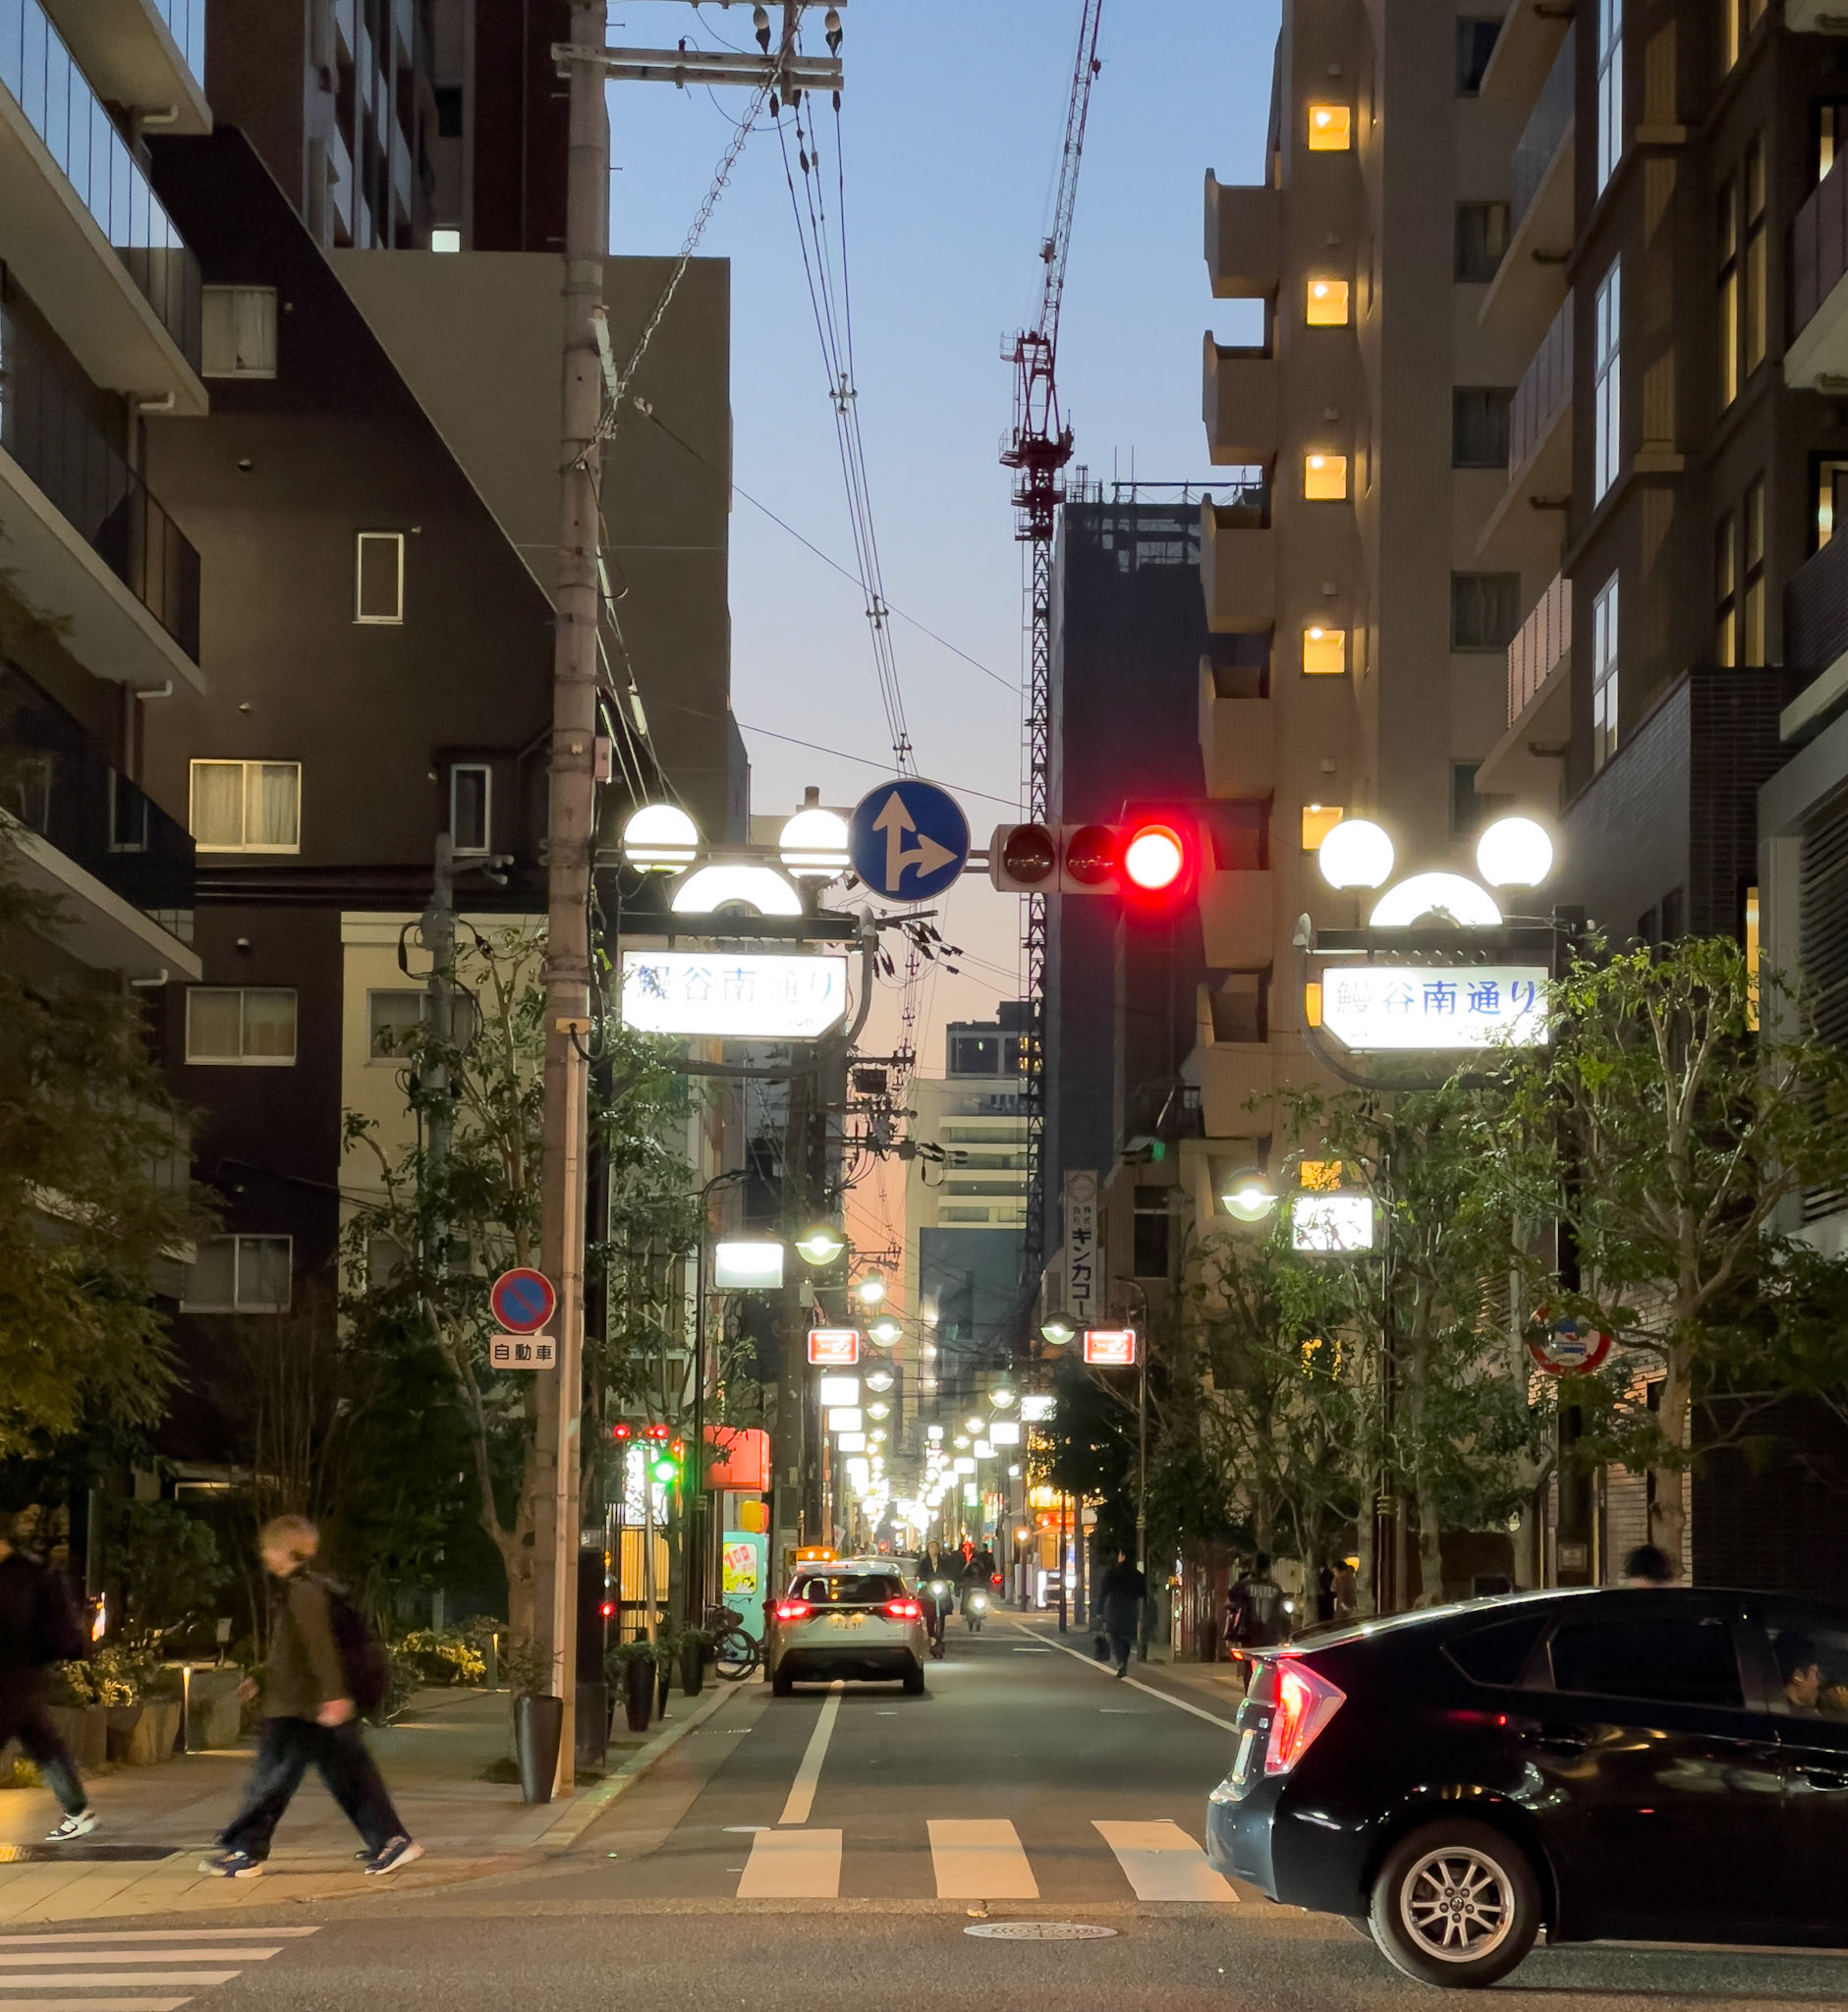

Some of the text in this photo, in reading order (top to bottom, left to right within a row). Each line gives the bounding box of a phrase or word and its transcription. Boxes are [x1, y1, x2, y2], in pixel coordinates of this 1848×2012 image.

[1336, 979, 1537, 1016] 鰻谷南通り
[1071, 1227, 1092, 1316] キンカコー
[494, 1343, 553, 1362] 自動車
